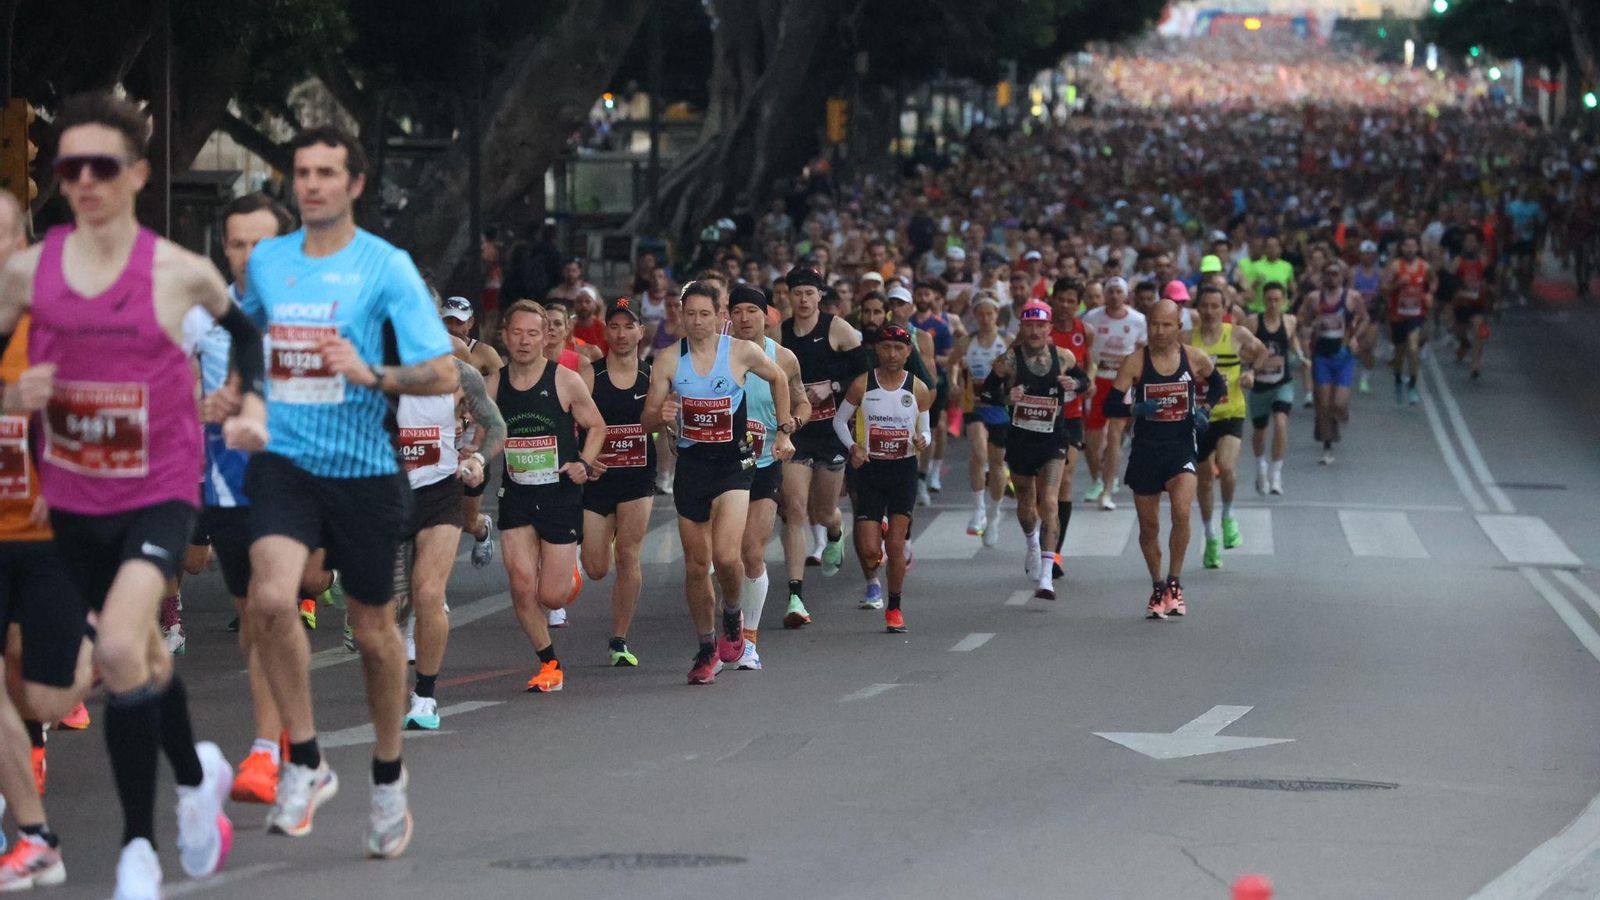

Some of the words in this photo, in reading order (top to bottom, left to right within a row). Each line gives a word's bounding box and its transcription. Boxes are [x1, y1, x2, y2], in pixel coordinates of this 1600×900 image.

[693, 400, 728, 408] GENERALI
[693, 413, 718, 423] 3921
[518, 439, 553, 447] GENERALI
[610, 440, 633, 449] 7484
[880, 441, 899, 449] 1054
[516, 454, 546, 464] 18035
